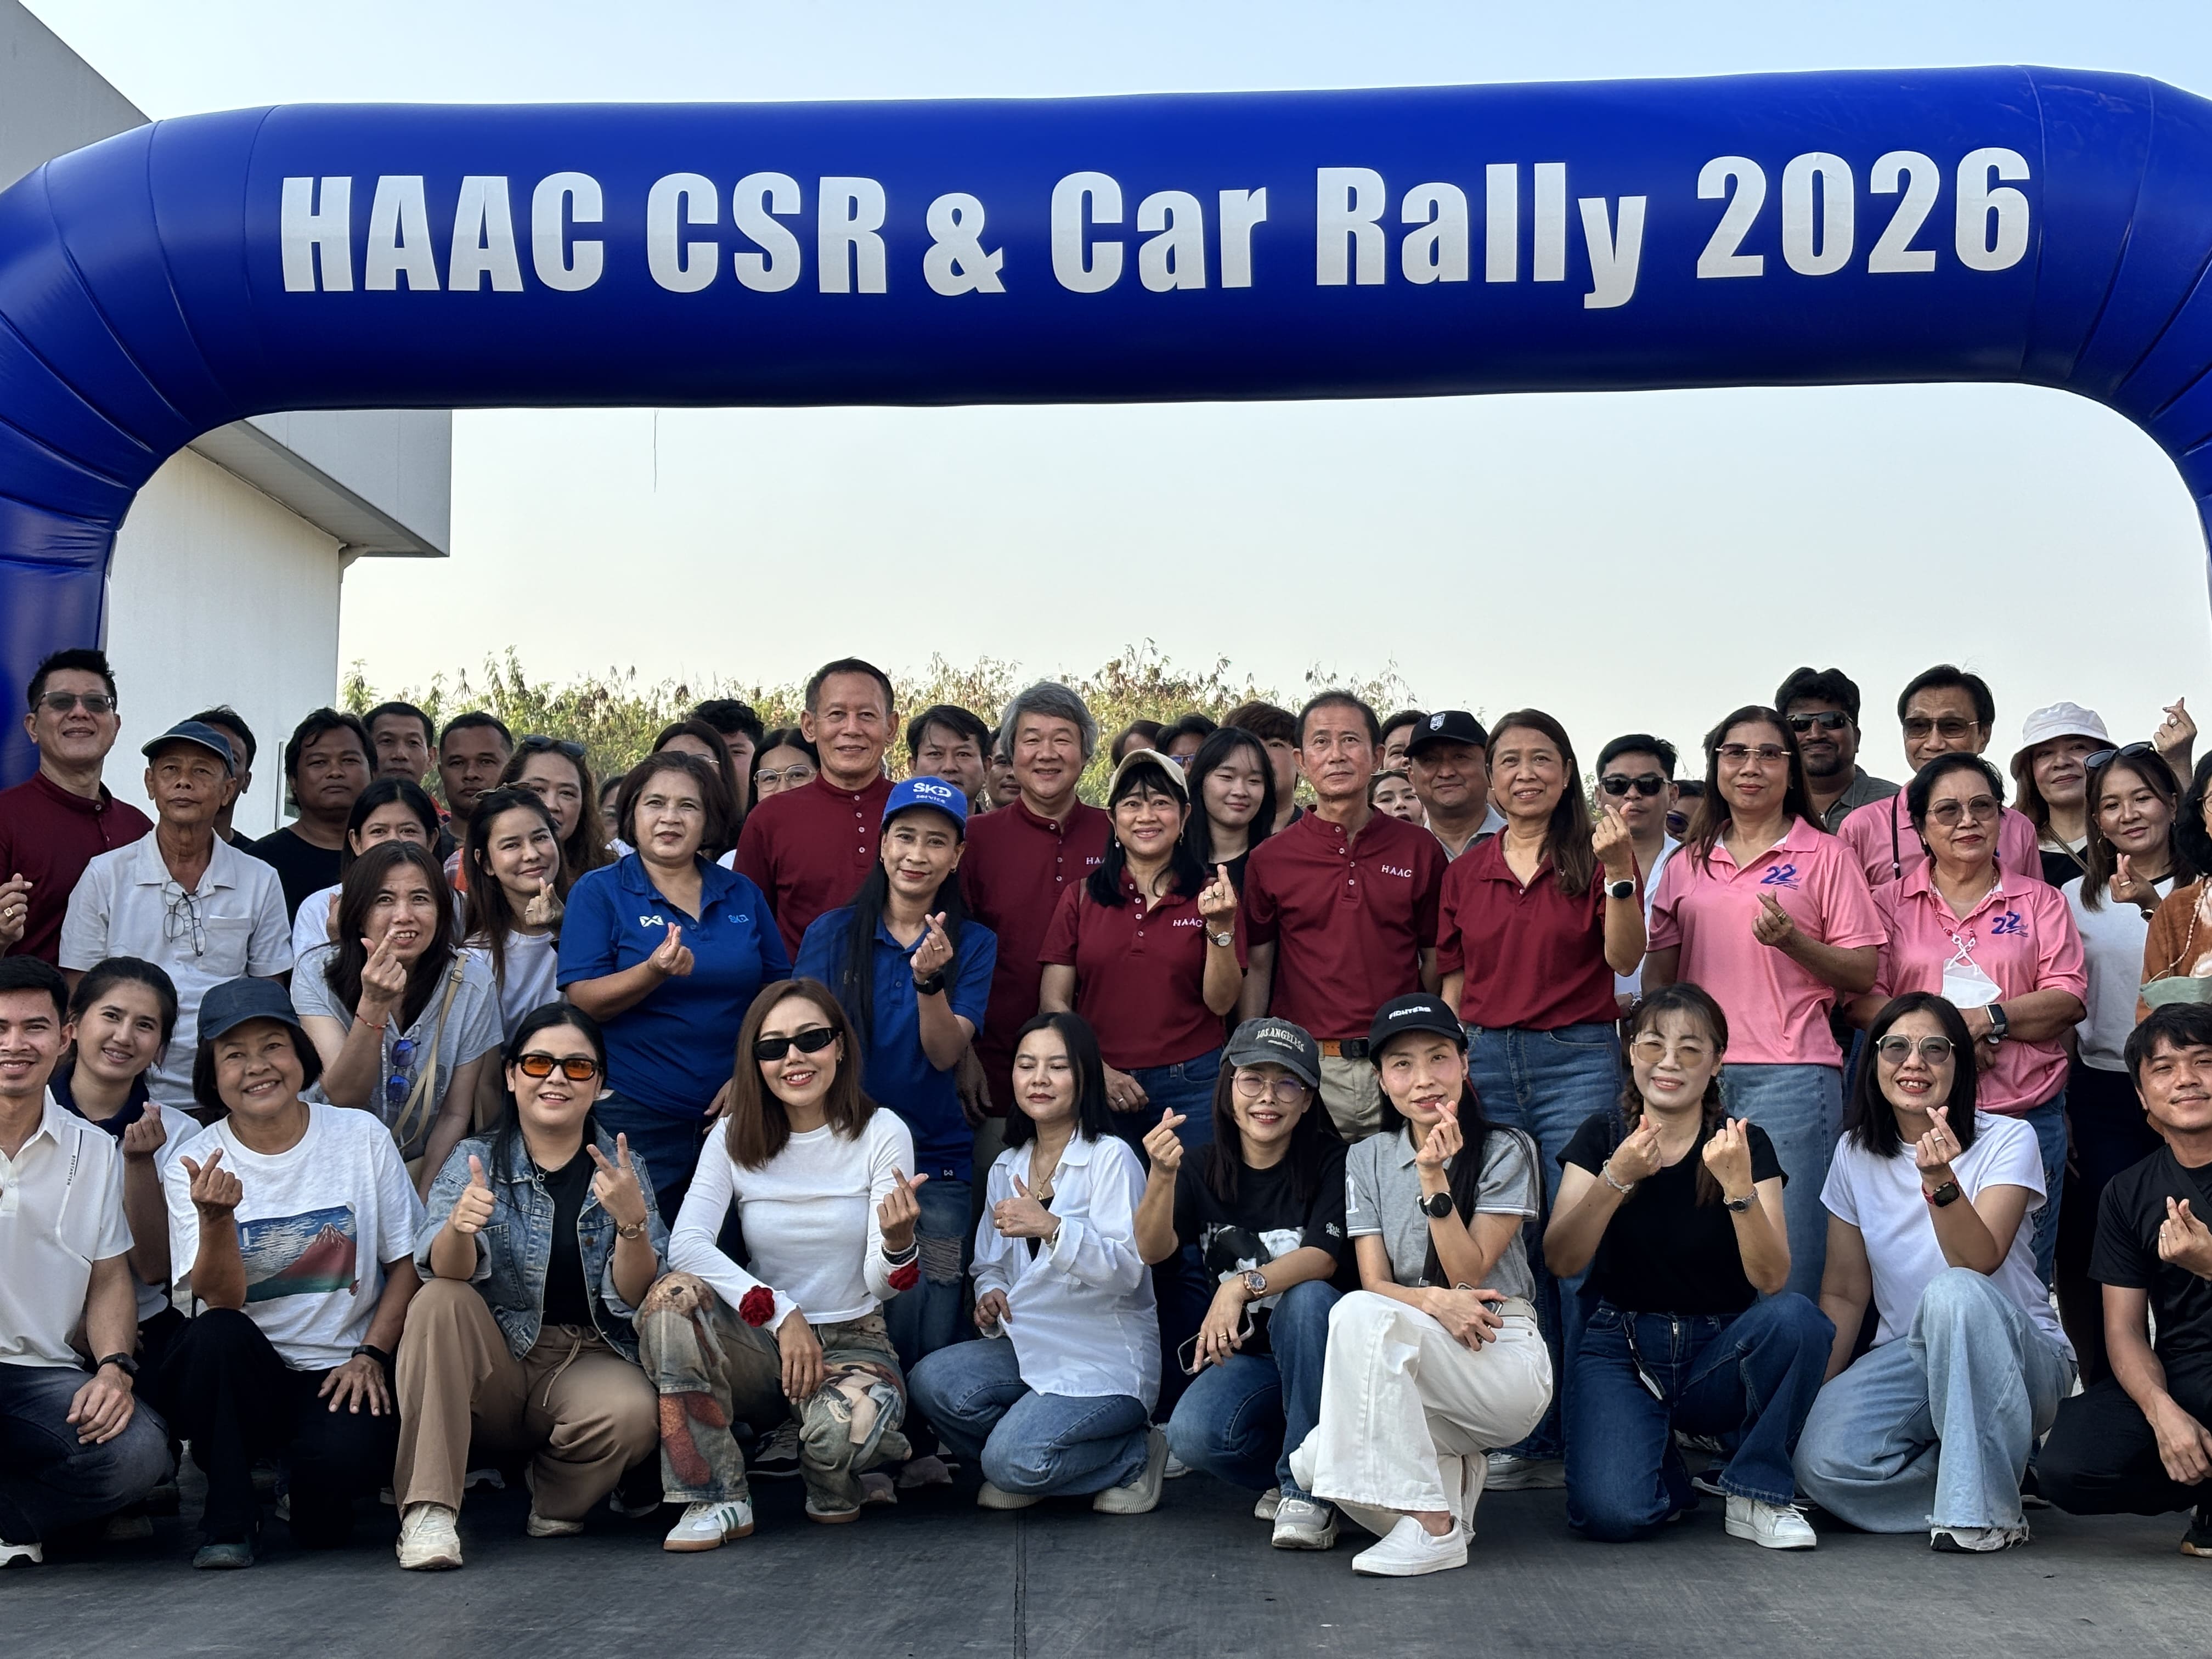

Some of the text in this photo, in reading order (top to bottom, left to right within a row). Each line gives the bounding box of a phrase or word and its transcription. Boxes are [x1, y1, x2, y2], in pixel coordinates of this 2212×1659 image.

[281, 147, 2030, 309] HAAC CSR & Car Rally 2026
[912, 782, 952, 798] SKD
[1086, 856, 1105, 865] HA
[1381, 864, 1412, 878] HAAC
[1172, 917, 1203, 928] HAAC
[1255, 1028, 1269, 1040] LOS
